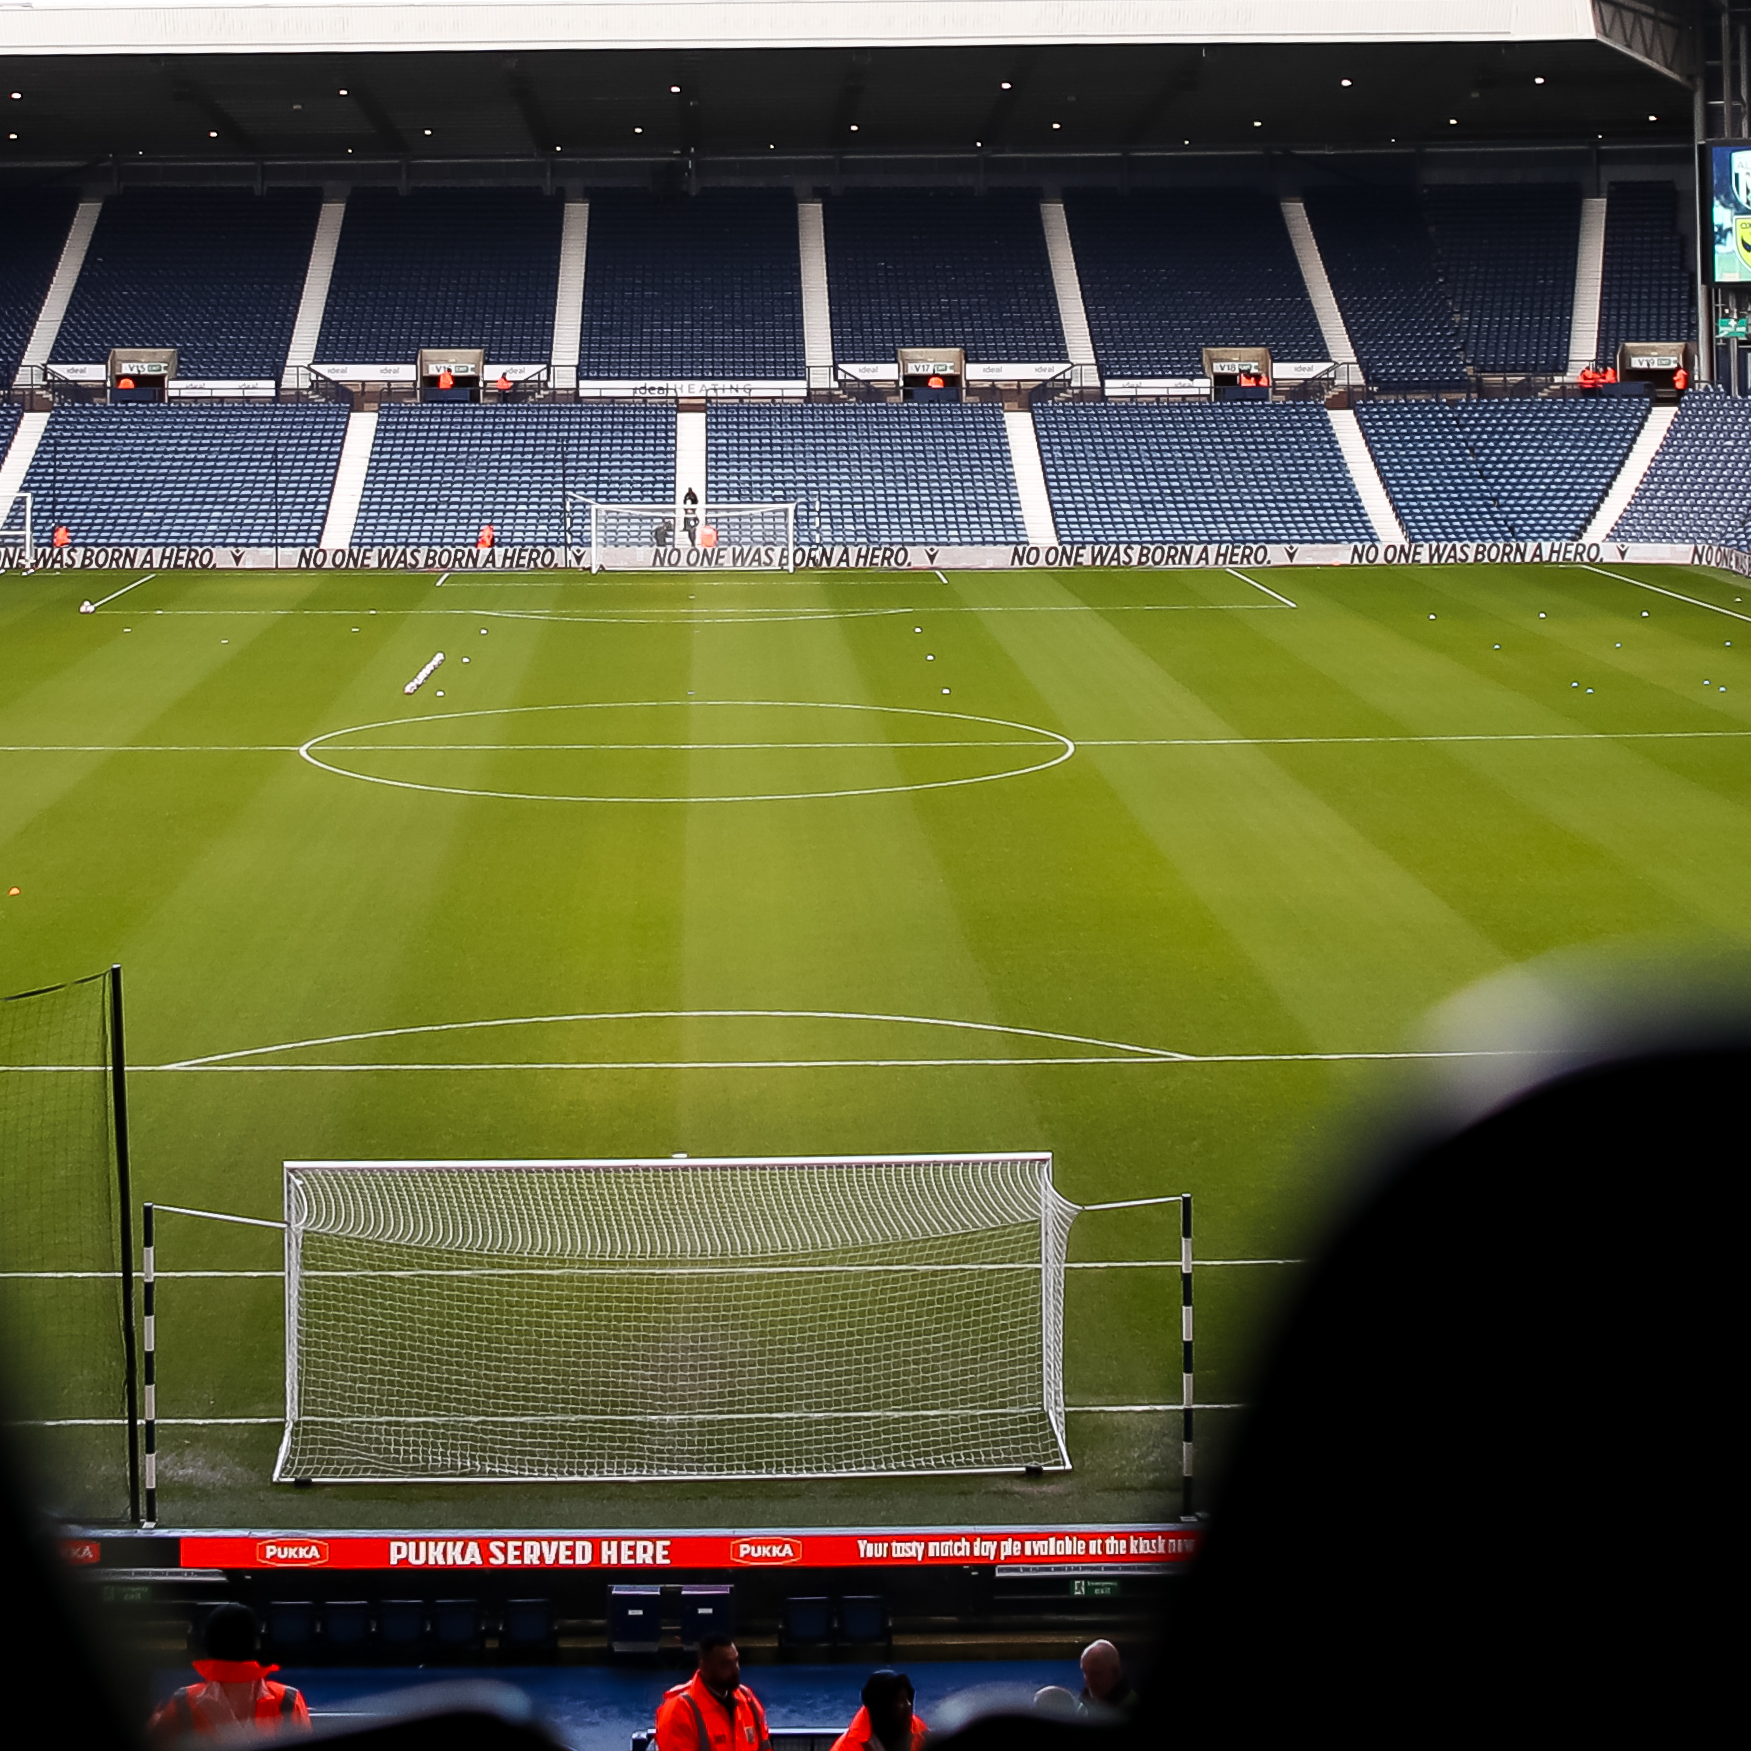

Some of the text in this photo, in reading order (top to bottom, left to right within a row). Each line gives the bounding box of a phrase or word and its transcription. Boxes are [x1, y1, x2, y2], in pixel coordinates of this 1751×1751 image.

[34, 548, 77, 569] WAS
[80, 548, 139, 569] BORN
[139, 549, 157, 569] A
[298, 548, 328, 569] NO
[331, 548, 374, 569] ONE
[377, 548, 421, 569] WAS
[424, 548, 480, 569] BORN
[481, 548, 497, 569] A
[652, 547, 912, 568] NO ONE WAS BORN A HERO.
[1010, 546, 1271, 567] NO ONE WAS BORN A HERO.
[1350, 543, 1604, 564] NO ONE WAS BORN A HERO.
[265, 1544, 321, 1560] PUKKA
[389, 1540, 672, 1565] PUKKA SERVED HERE
[738, 1543, 794, 1558] PUKKA
[857, 1539, 889, 1558] Your
[891, 1540, 925, 1561] tasty
[928, 1537, 970, 1557] match
[973, 1537, 997, 1561] day
[1000, 1537, 1022, 1561] pie
[1024, 1536, 1086, 1556] available
[1088, 1537, 1103, 1555] at
[1105, 1535, 1127, 1555] the
[1129, 1535, 1167, 1554] kiosk
